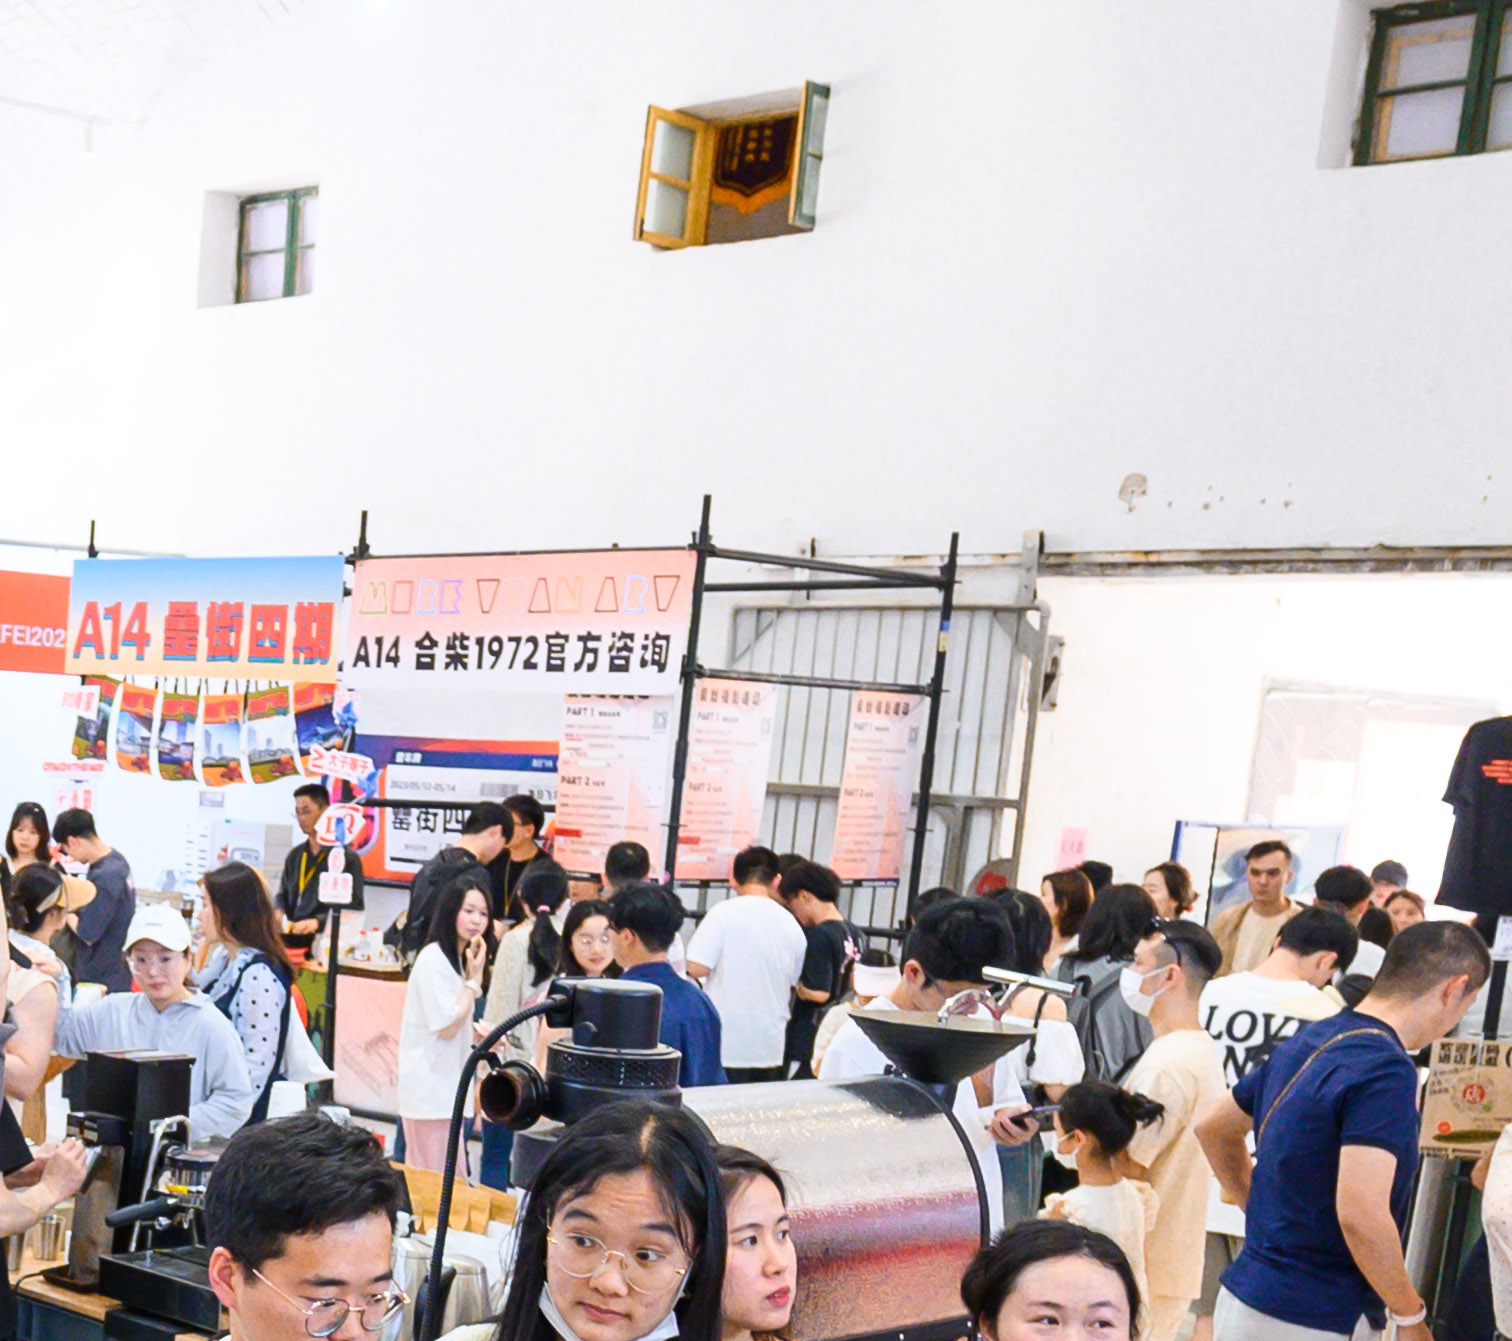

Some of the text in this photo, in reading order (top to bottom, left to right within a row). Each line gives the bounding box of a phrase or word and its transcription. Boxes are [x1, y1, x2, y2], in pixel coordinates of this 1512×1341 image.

[73, 601, 151, 661] A14
[352, 631, 672, 673] A14 合柴1972官方咨询
